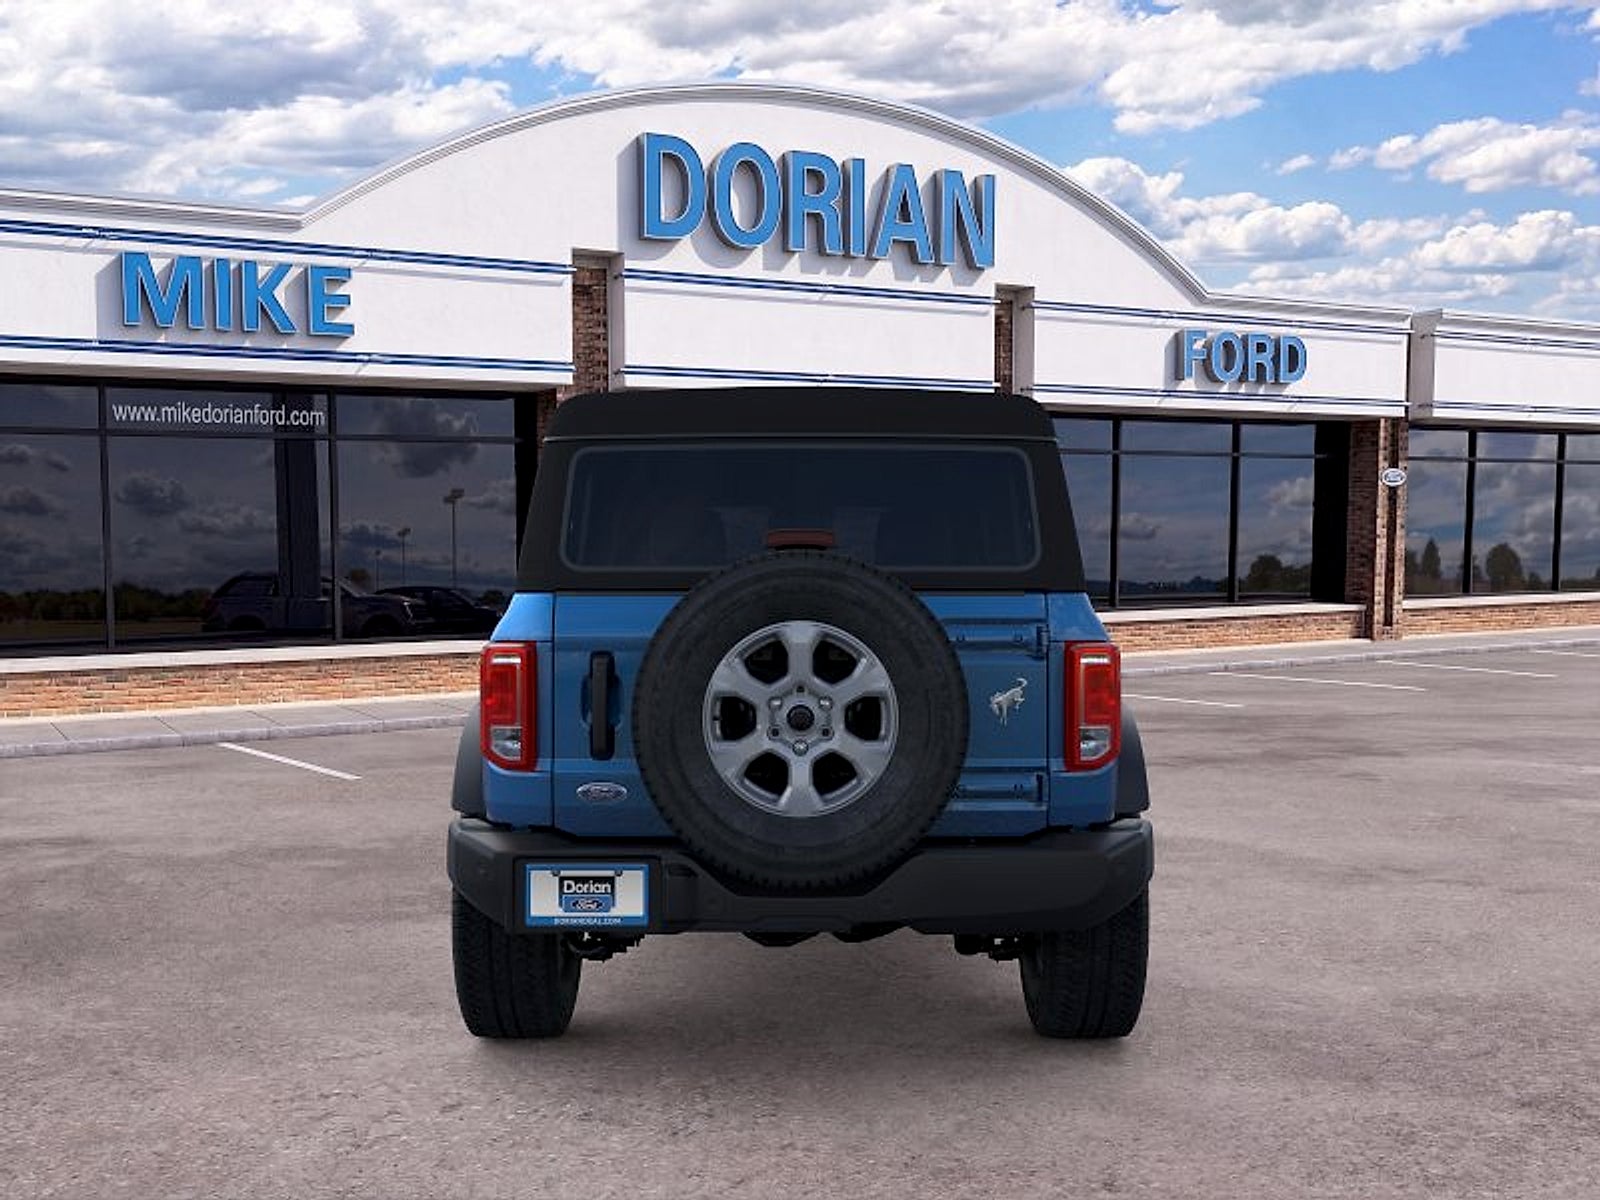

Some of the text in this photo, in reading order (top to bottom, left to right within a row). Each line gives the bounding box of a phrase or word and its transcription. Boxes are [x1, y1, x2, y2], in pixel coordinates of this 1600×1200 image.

[640, 132, 996, 270] DORIAN
[121, 251, 355, 337] MIKE
[1178, 329, 1308, 384] FORD
[112, 402, 326, 427] www.mikedorianford.com
[563, 880, 611, 893] Dorian
